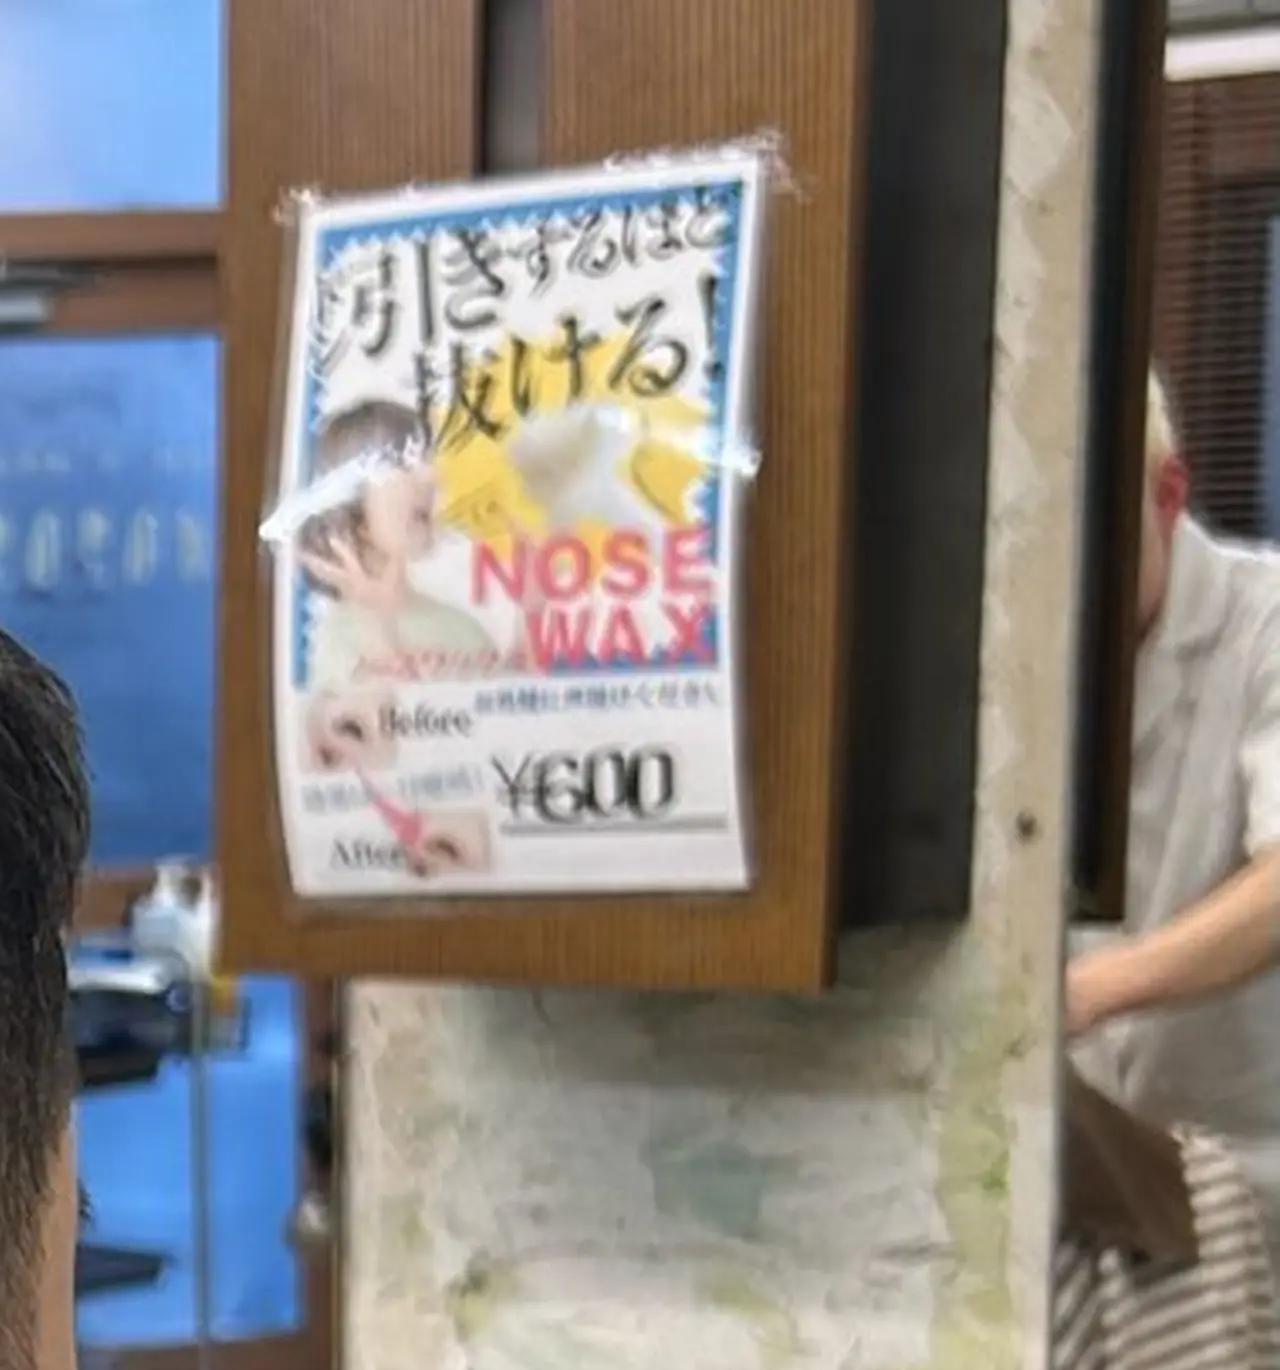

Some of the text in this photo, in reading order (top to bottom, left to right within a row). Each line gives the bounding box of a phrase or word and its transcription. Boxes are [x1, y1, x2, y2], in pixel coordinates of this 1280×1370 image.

[471, 525, 716, 604] NOSE
[526, 600, 717, 670] WAX
[378, 700, 473, 740] Before
[490, 746, 676, 826] ¥600
